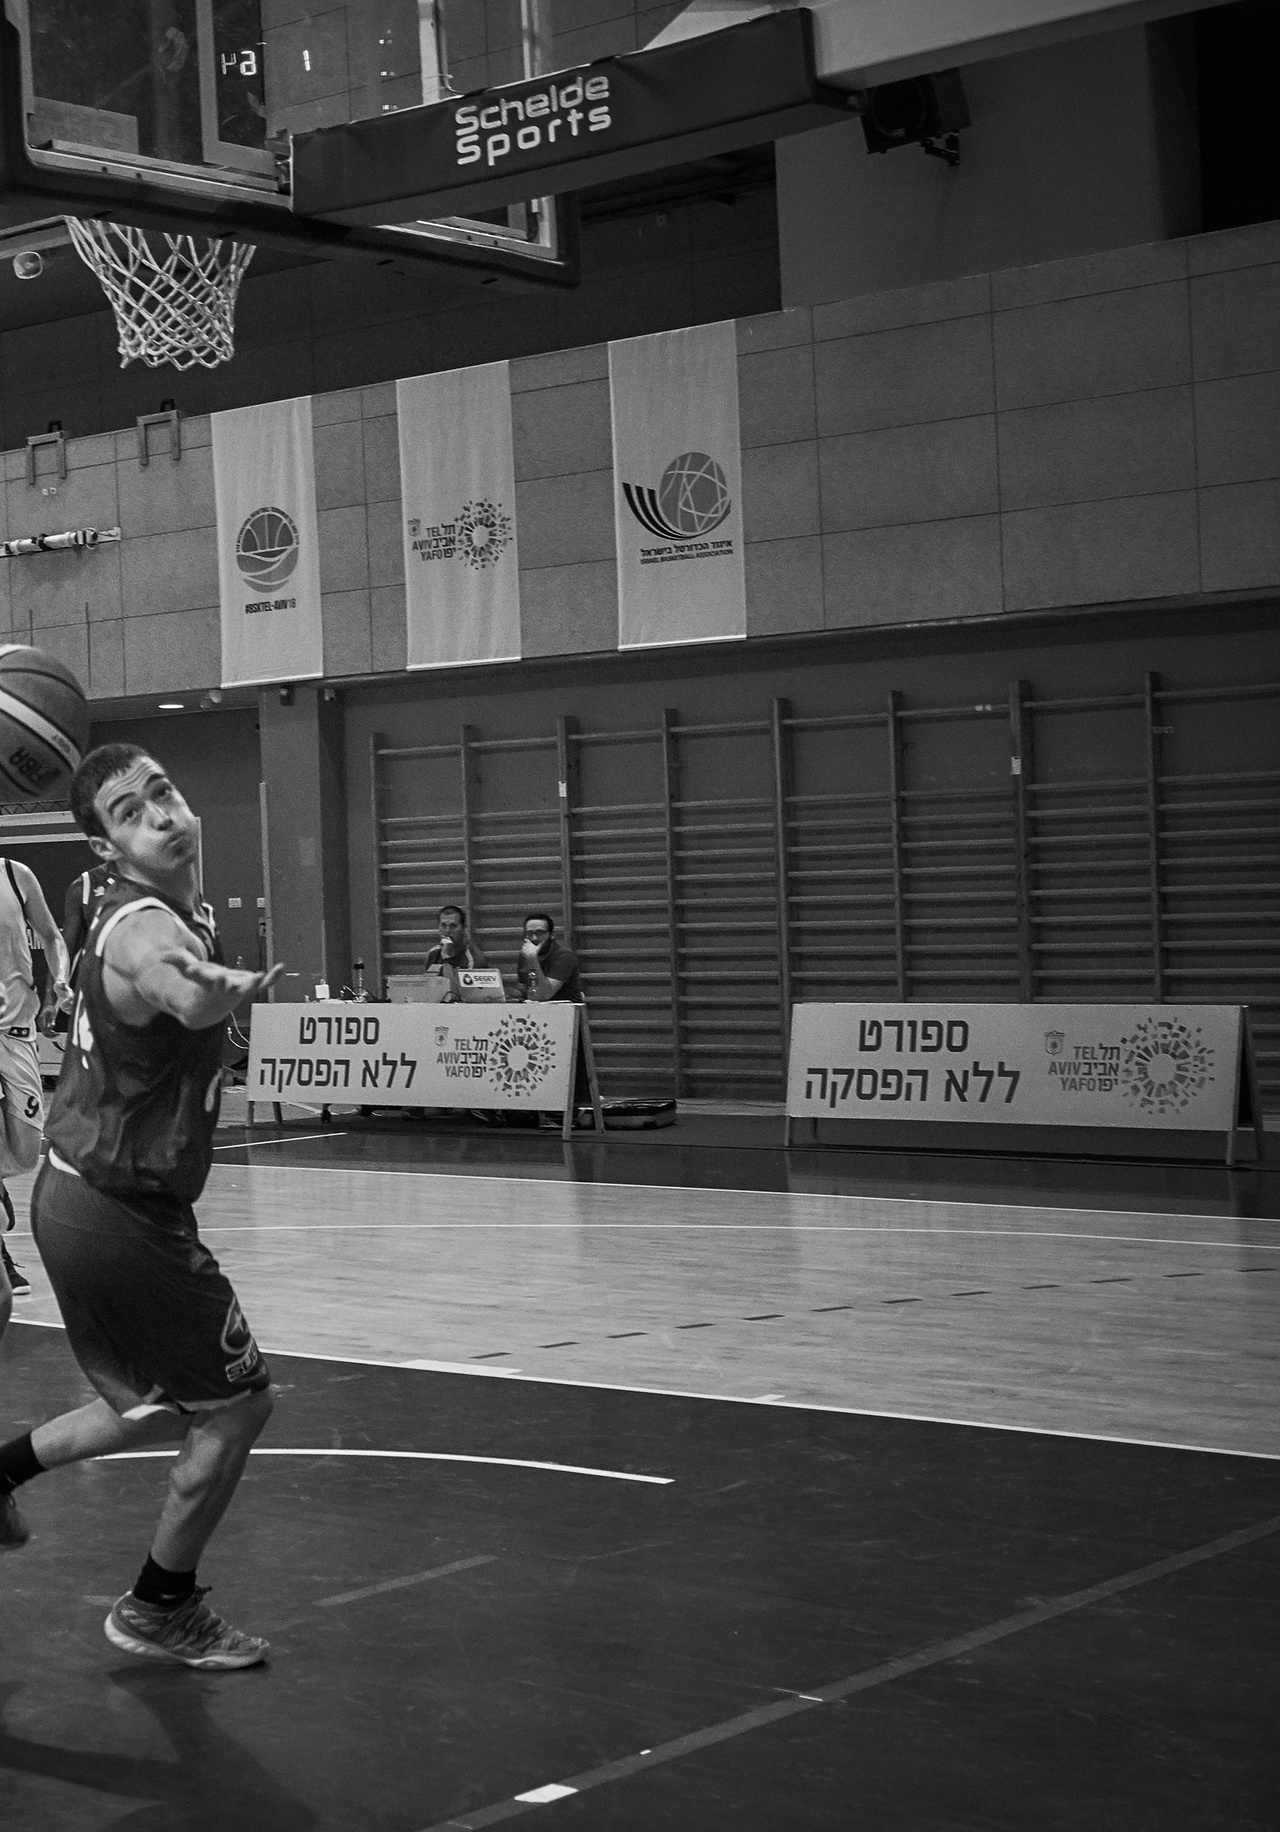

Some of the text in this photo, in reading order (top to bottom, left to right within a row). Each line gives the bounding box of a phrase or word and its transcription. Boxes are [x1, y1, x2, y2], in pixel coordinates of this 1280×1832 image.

[455, 76, 610, 136] Schelde
[456, 105, 612, 166] Sports
[426, 526, 441, 537] TEL
[441, 523, 456, 535] תל
[432, 536, 456, 548] אביב
[299, 1016, 380, 1045] ספורט
[858, 1019, 969, 1052] ספורט
[455, 1038, 472, 1051] TEL
[472, 1035, 488, 1051] תל
[436, 1051, 460, 1064] AVIV
[460, 1052, 487, 1065] אביב
[1073, 1045, 1098, 1060] TEL
[1099, 1042, 1121, 1060] תל
[259, 1052, 418, 1093] ללא הפסקה
[446, 1065, 470, 1078] YAFO
[472, 1065, 487, 1078] יפו
[1048, 1061, 1081, 1076] AVIV
[1081, 1062, 1119, 1076] אביב
[805, 1061, 1021, 1108] ללא הפסקה
[1060, 1076, 1097, 1092] YAFO
[1098, 1077, 1118, 1092] יפו
[24, 1095, 40, 1119] 9
